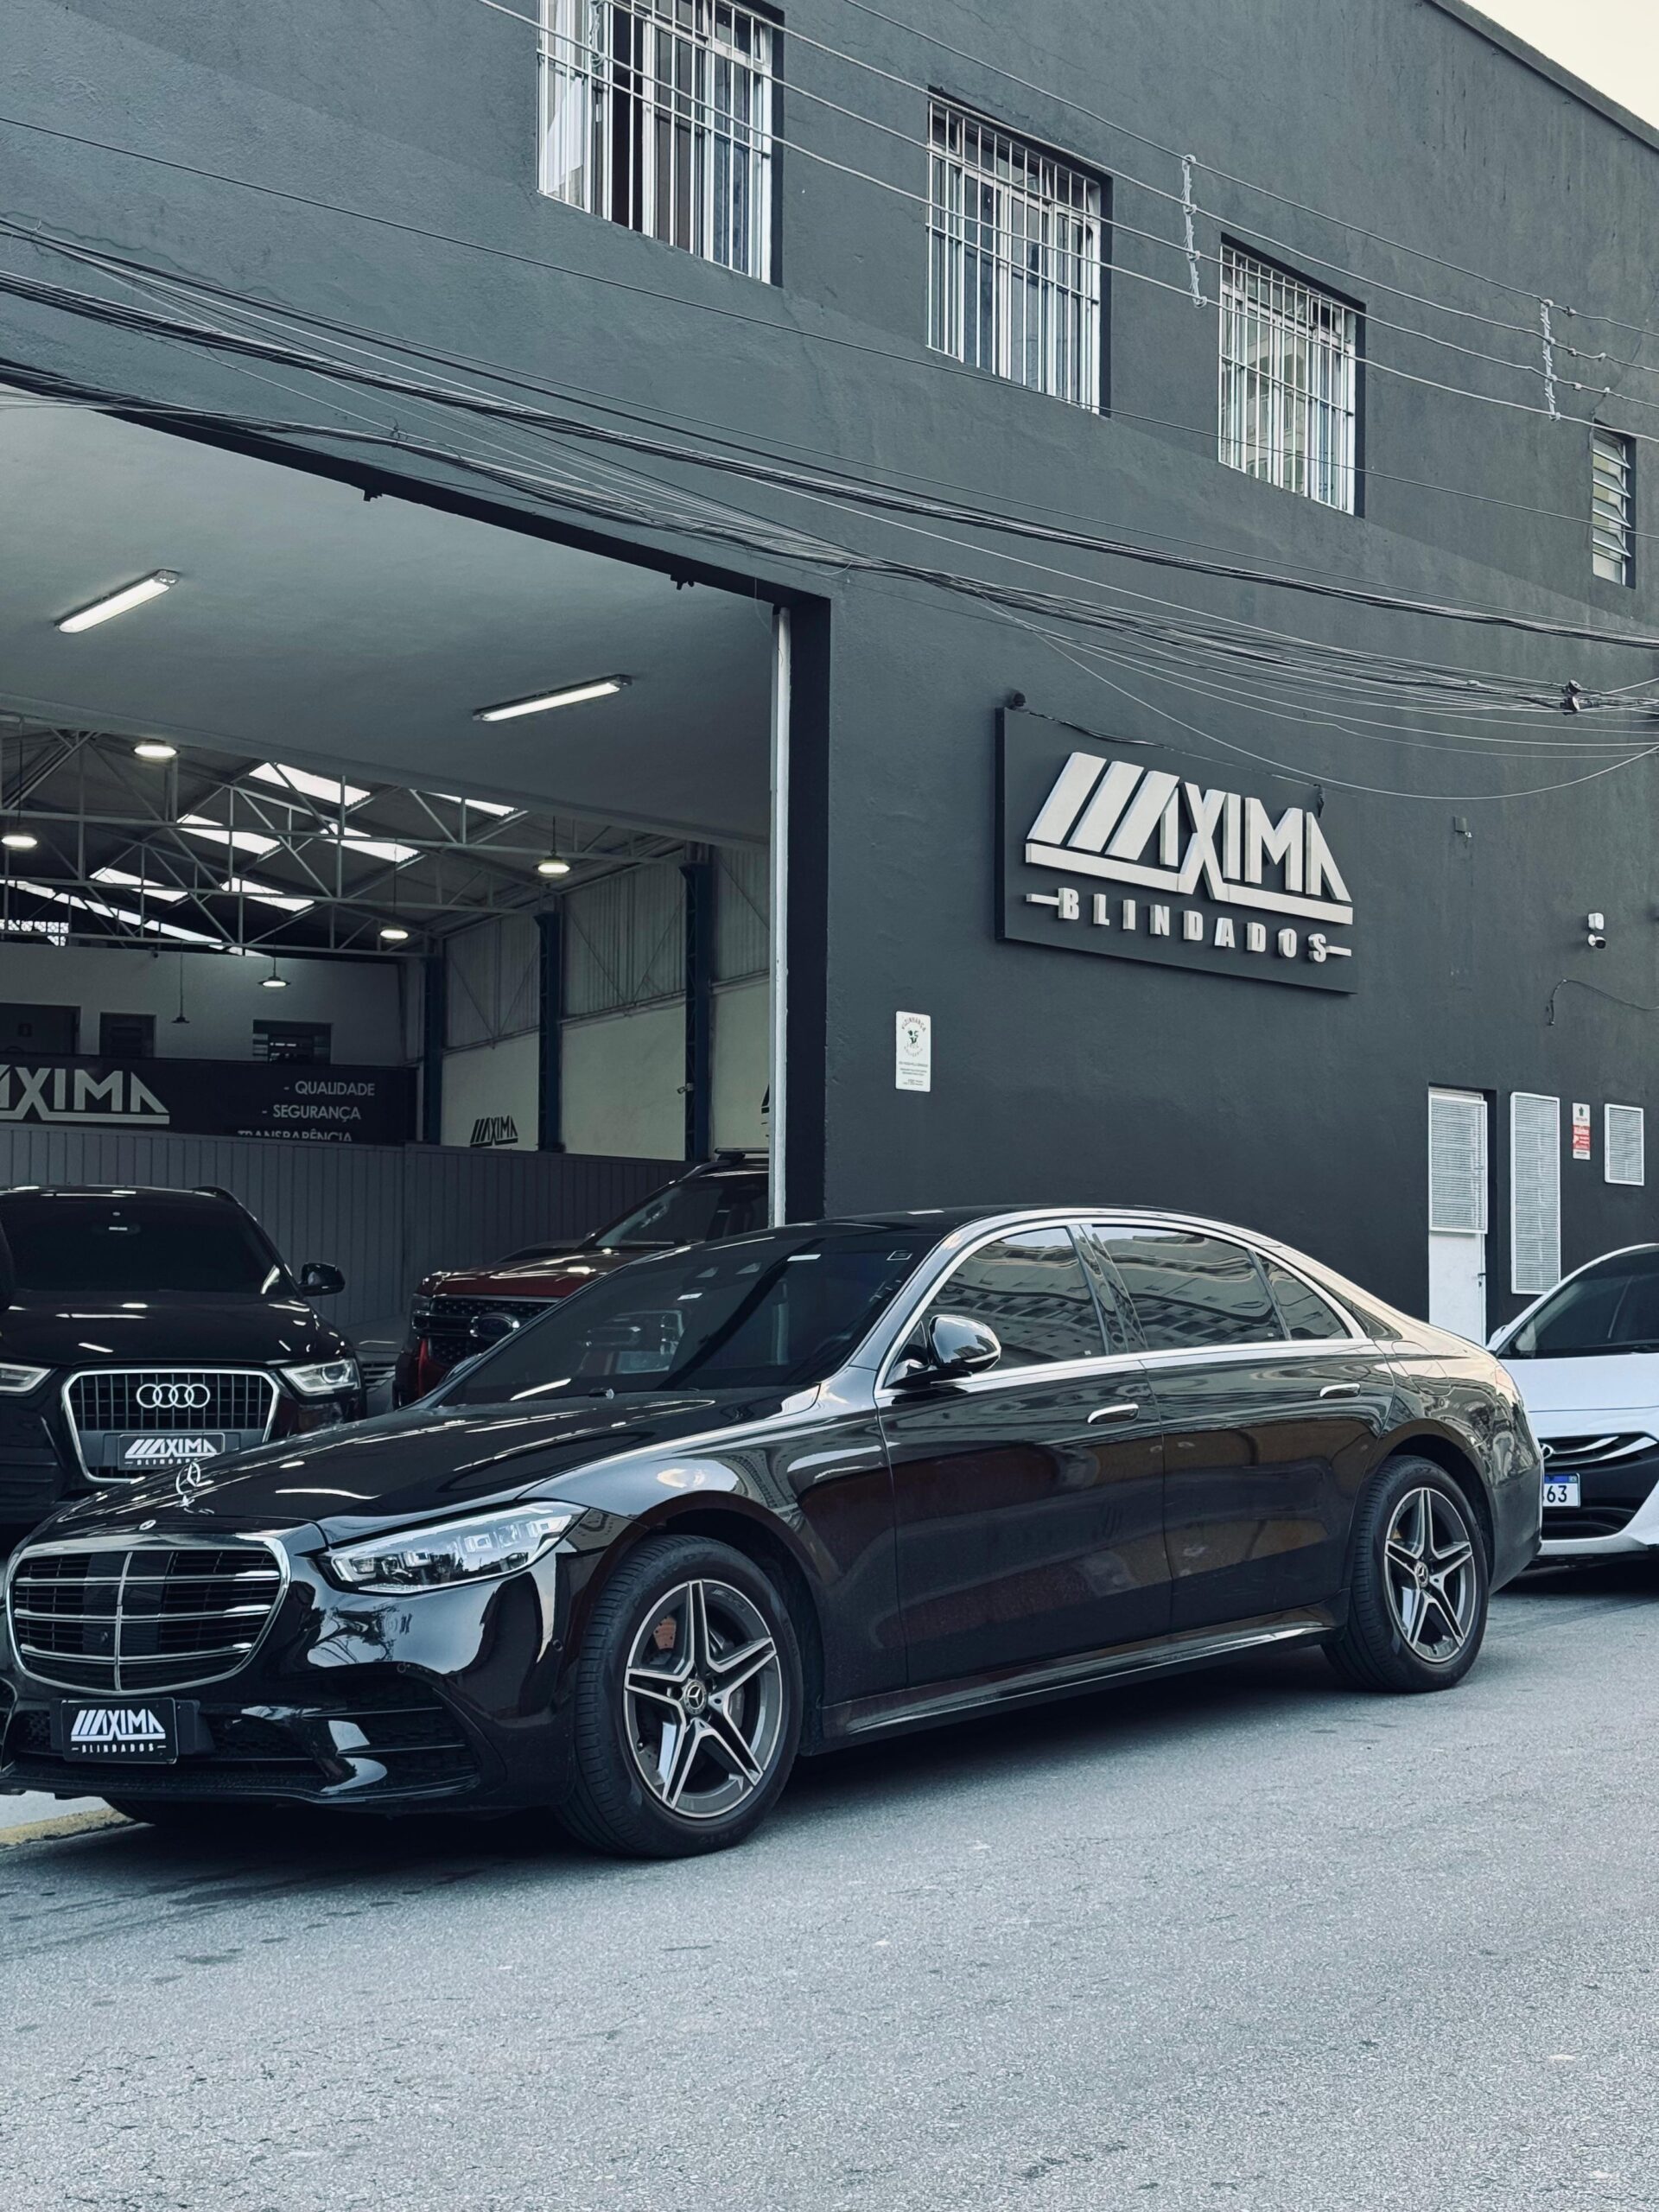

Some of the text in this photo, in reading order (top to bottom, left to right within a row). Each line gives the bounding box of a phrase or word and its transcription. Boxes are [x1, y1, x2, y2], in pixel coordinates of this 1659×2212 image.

[1058, 887, 1326, 963] BLINDADOS
[0, 1065, 169, 1124] XIMA
[295, 1081, 375, 1096] QUALIDADE
[273, 1105, 361, 1122] SEGURANÇA
[1543, 1485, 1567, 1503] 63
